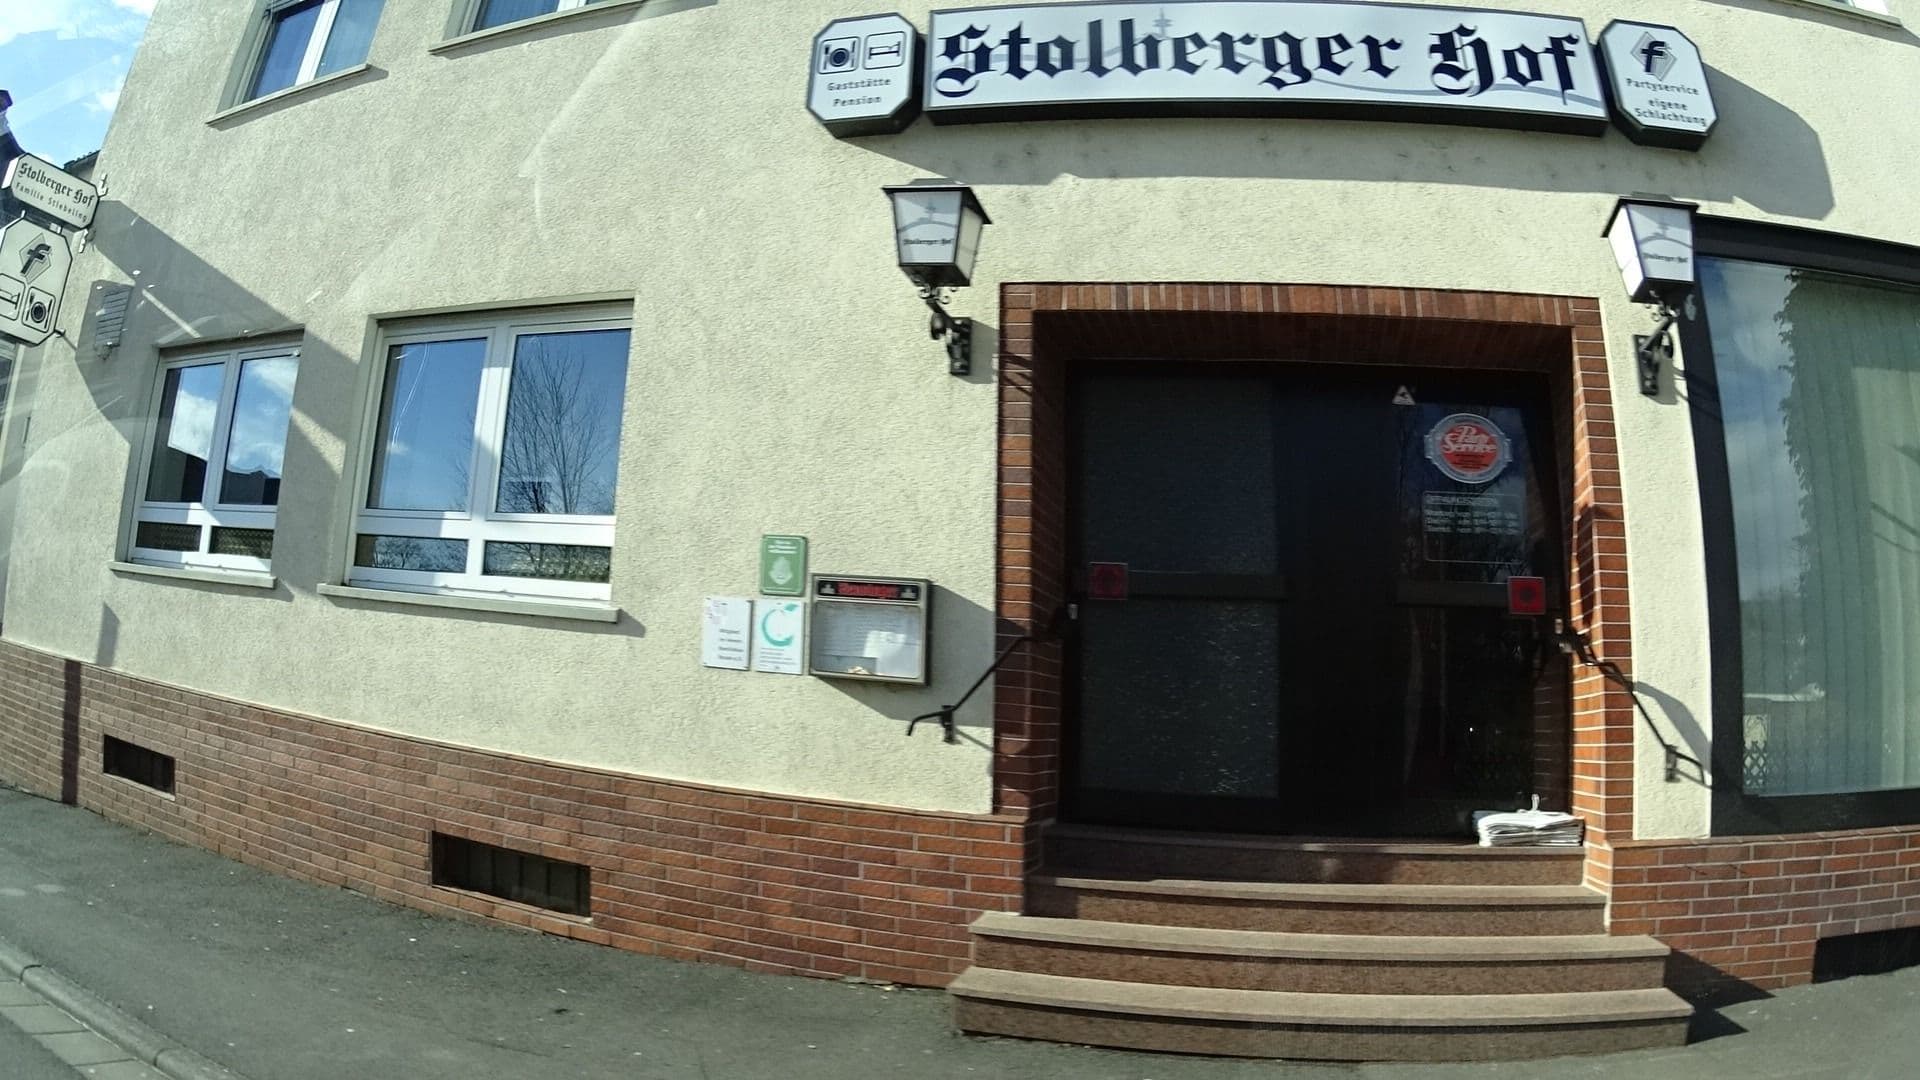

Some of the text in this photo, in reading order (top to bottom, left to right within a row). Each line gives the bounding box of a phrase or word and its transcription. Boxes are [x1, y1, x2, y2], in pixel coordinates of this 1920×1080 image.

[934, 17, 1579, 105] Stolberger Hof
[827, 78, 892, 92] Gaststätte
[1626, 78, 1699, 95] Partyservice
[833, 96, 883, 107] Pension
[1648, 98, 1689, 111] eigene
[1634, 107, 1707, 127] Schlachtung
[16, 181, 45, 201] Familie
[18, 162, 95, 207] Stolberger Hof
